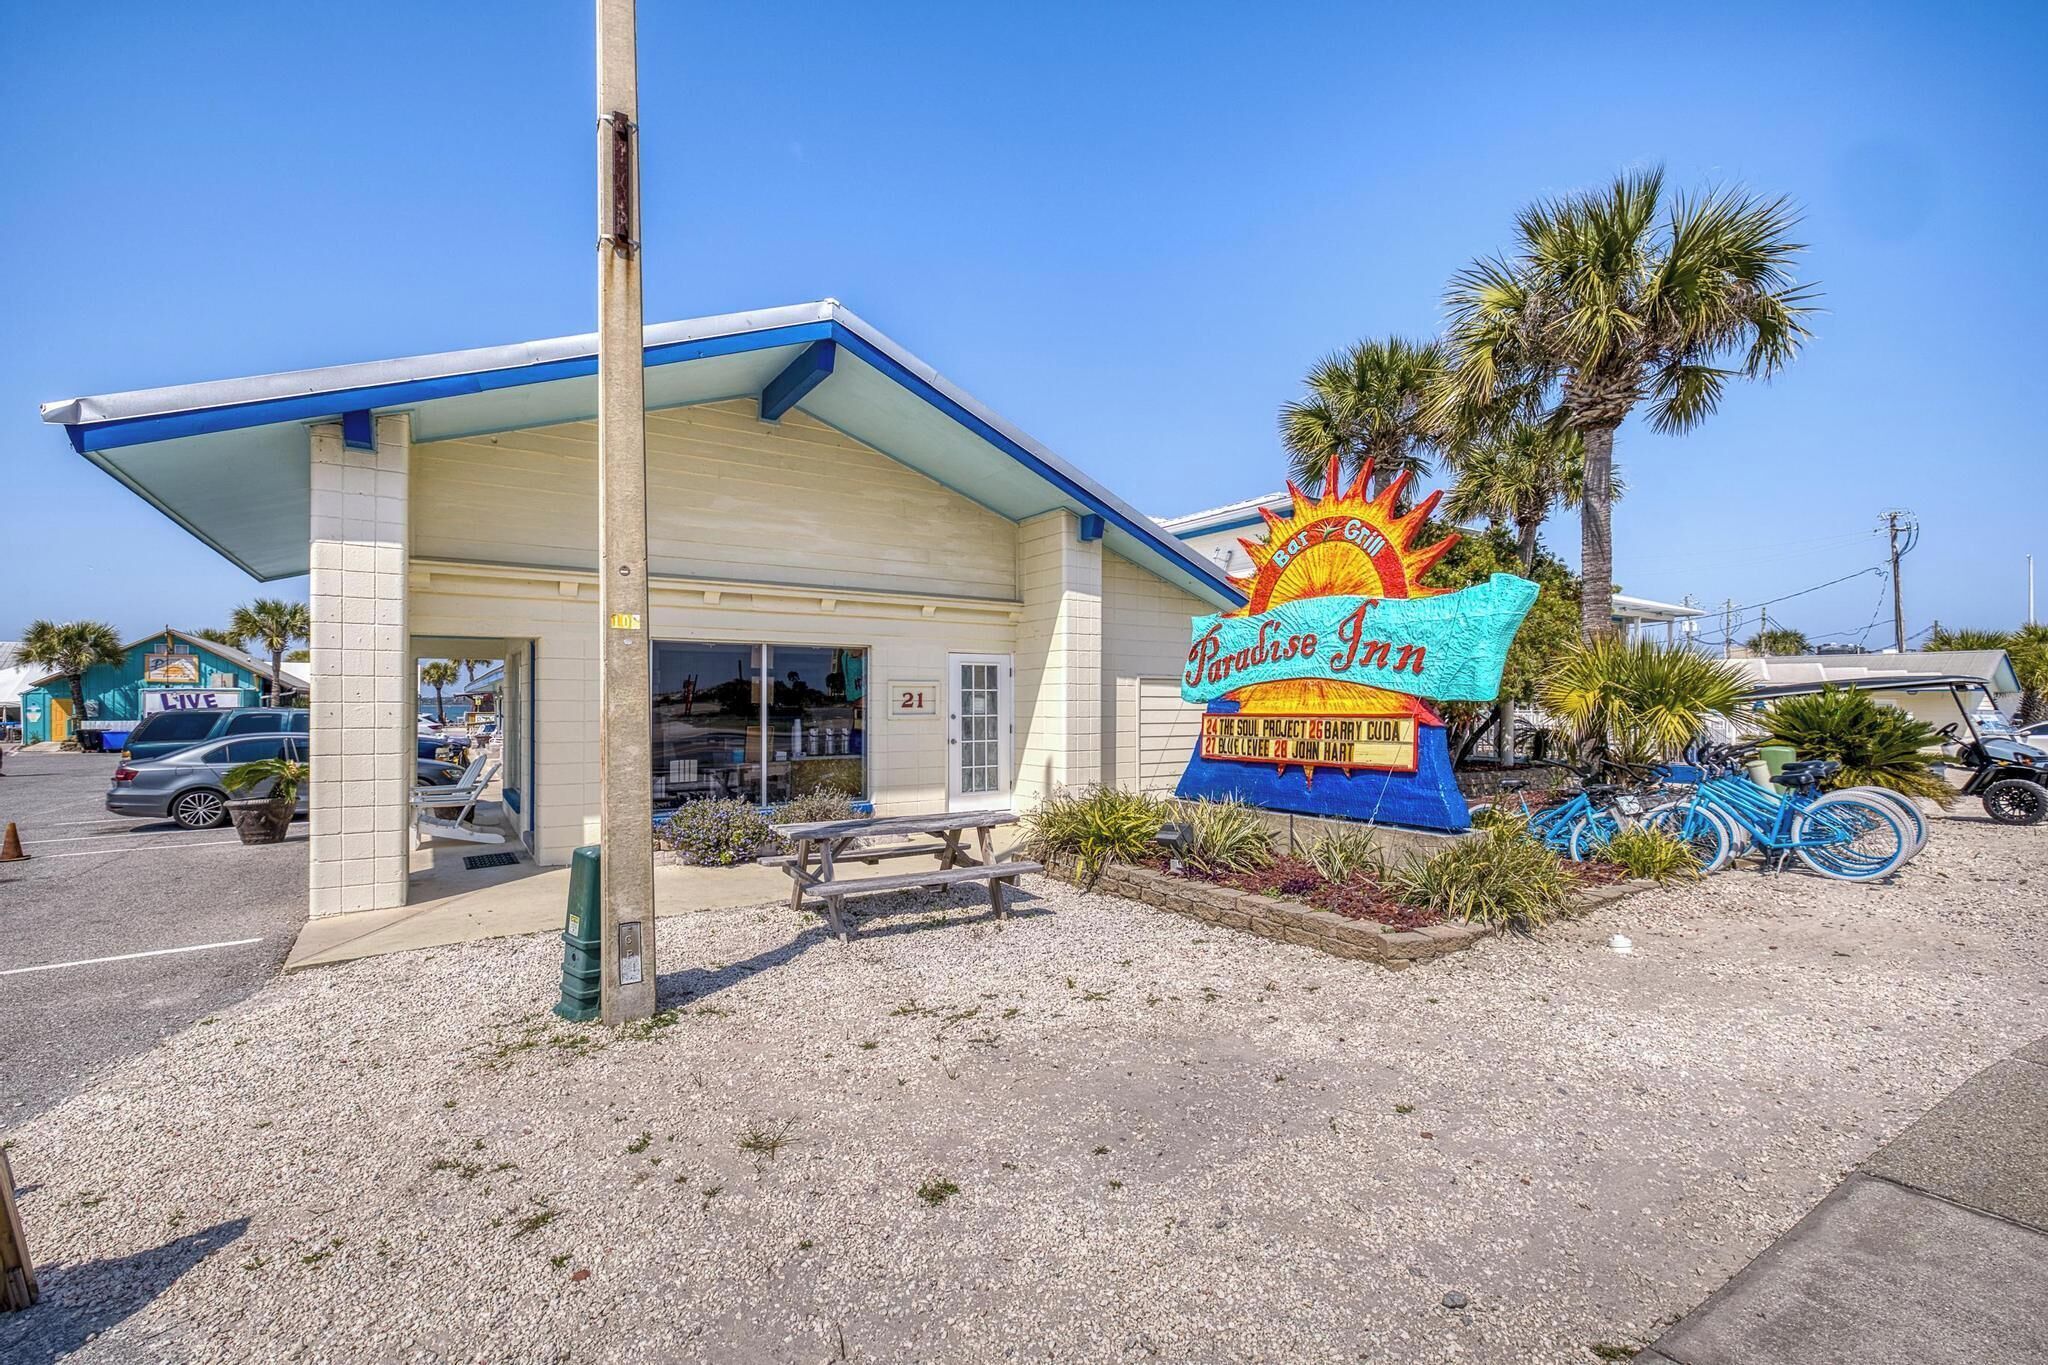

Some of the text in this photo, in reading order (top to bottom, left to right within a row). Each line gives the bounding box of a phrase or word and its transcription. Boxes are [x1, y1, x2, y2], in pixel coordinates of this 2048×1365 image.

[1272, 519, 1386, 569] Bar Grill
[1185, 598, 1428, 688] Paradise Inn
[160, 693, 218, 711] LIVE
[901, 692, 923, 709] 21
[1206, 718, 1400, 741] 24 THE SOUL PROJECT 26 BARRY CUDA
[1205, 736, 1355, 762] 27 BLUE LEVEE 28 JOHN HART
